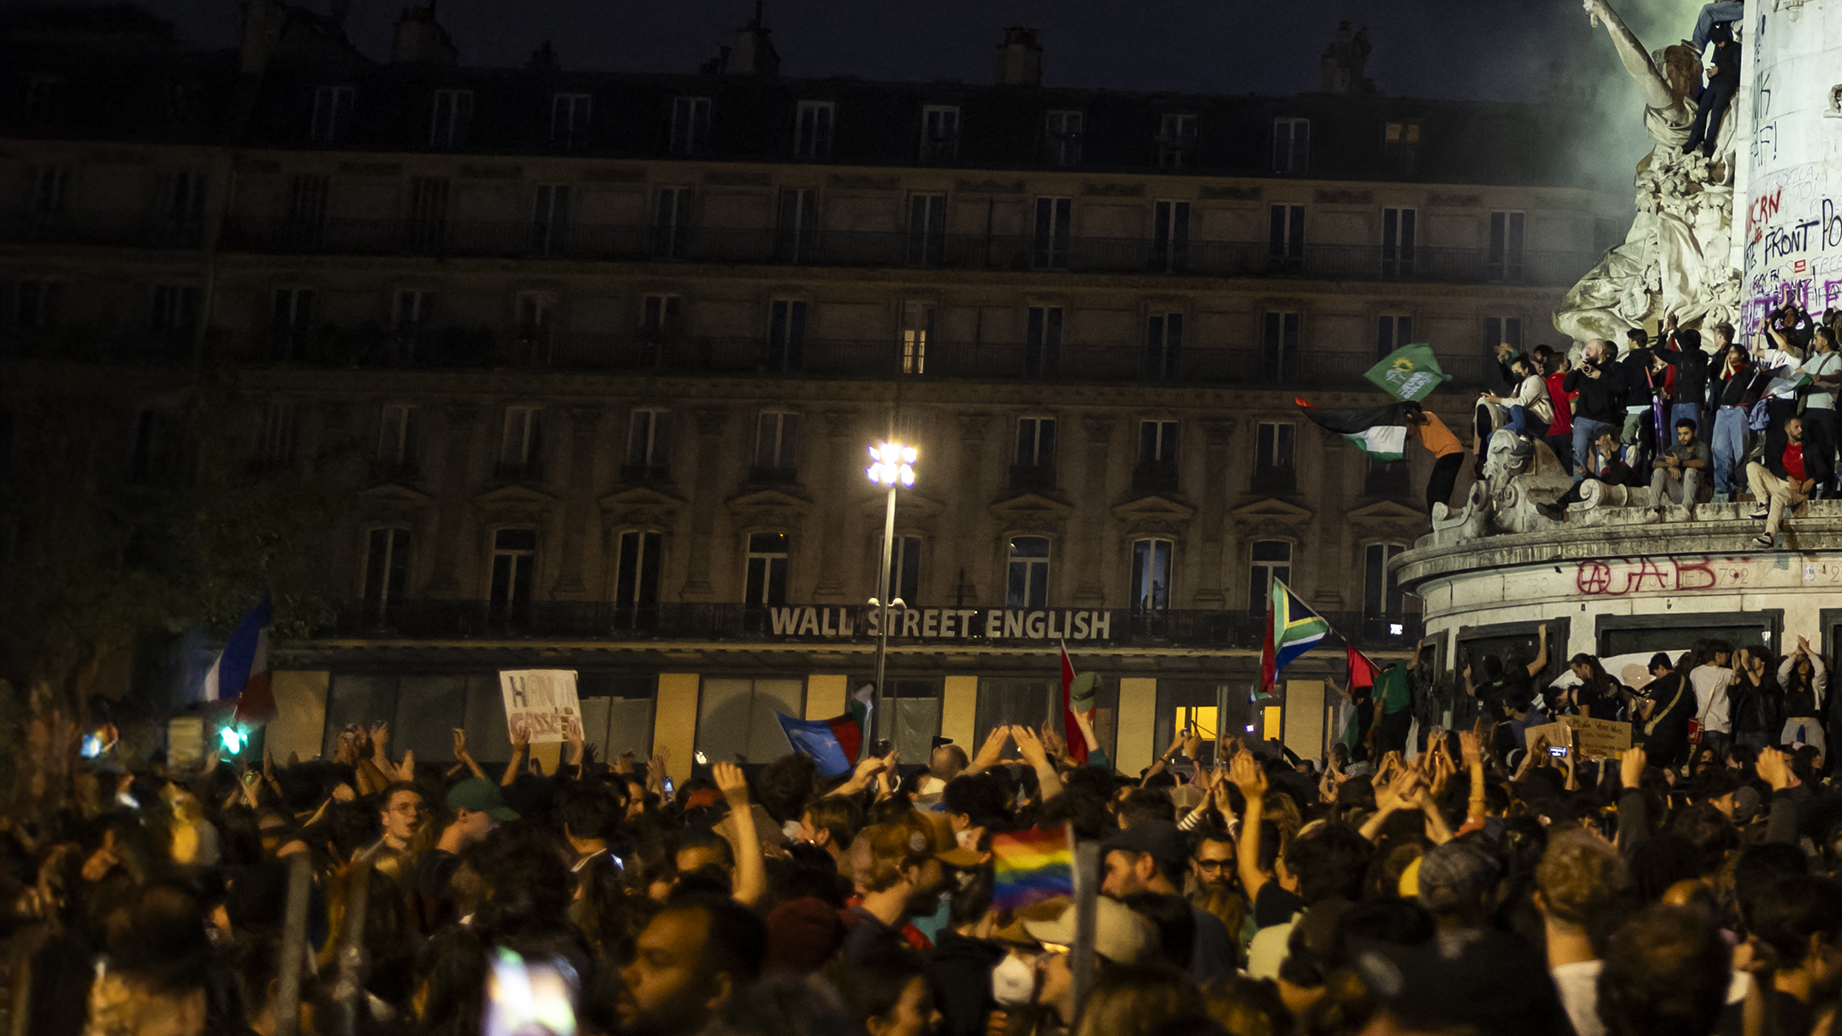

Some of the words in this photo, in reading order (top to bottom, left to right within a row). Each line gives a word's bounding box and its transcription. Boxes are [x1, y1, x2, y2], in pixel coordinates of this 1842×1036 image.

[1764, 220, 1820, 266] FRONT
[771, 606, 857, 637] WALL
[867, 607, 971, 638] STREET
[985, 609, 1110, 641] ENGLISH
